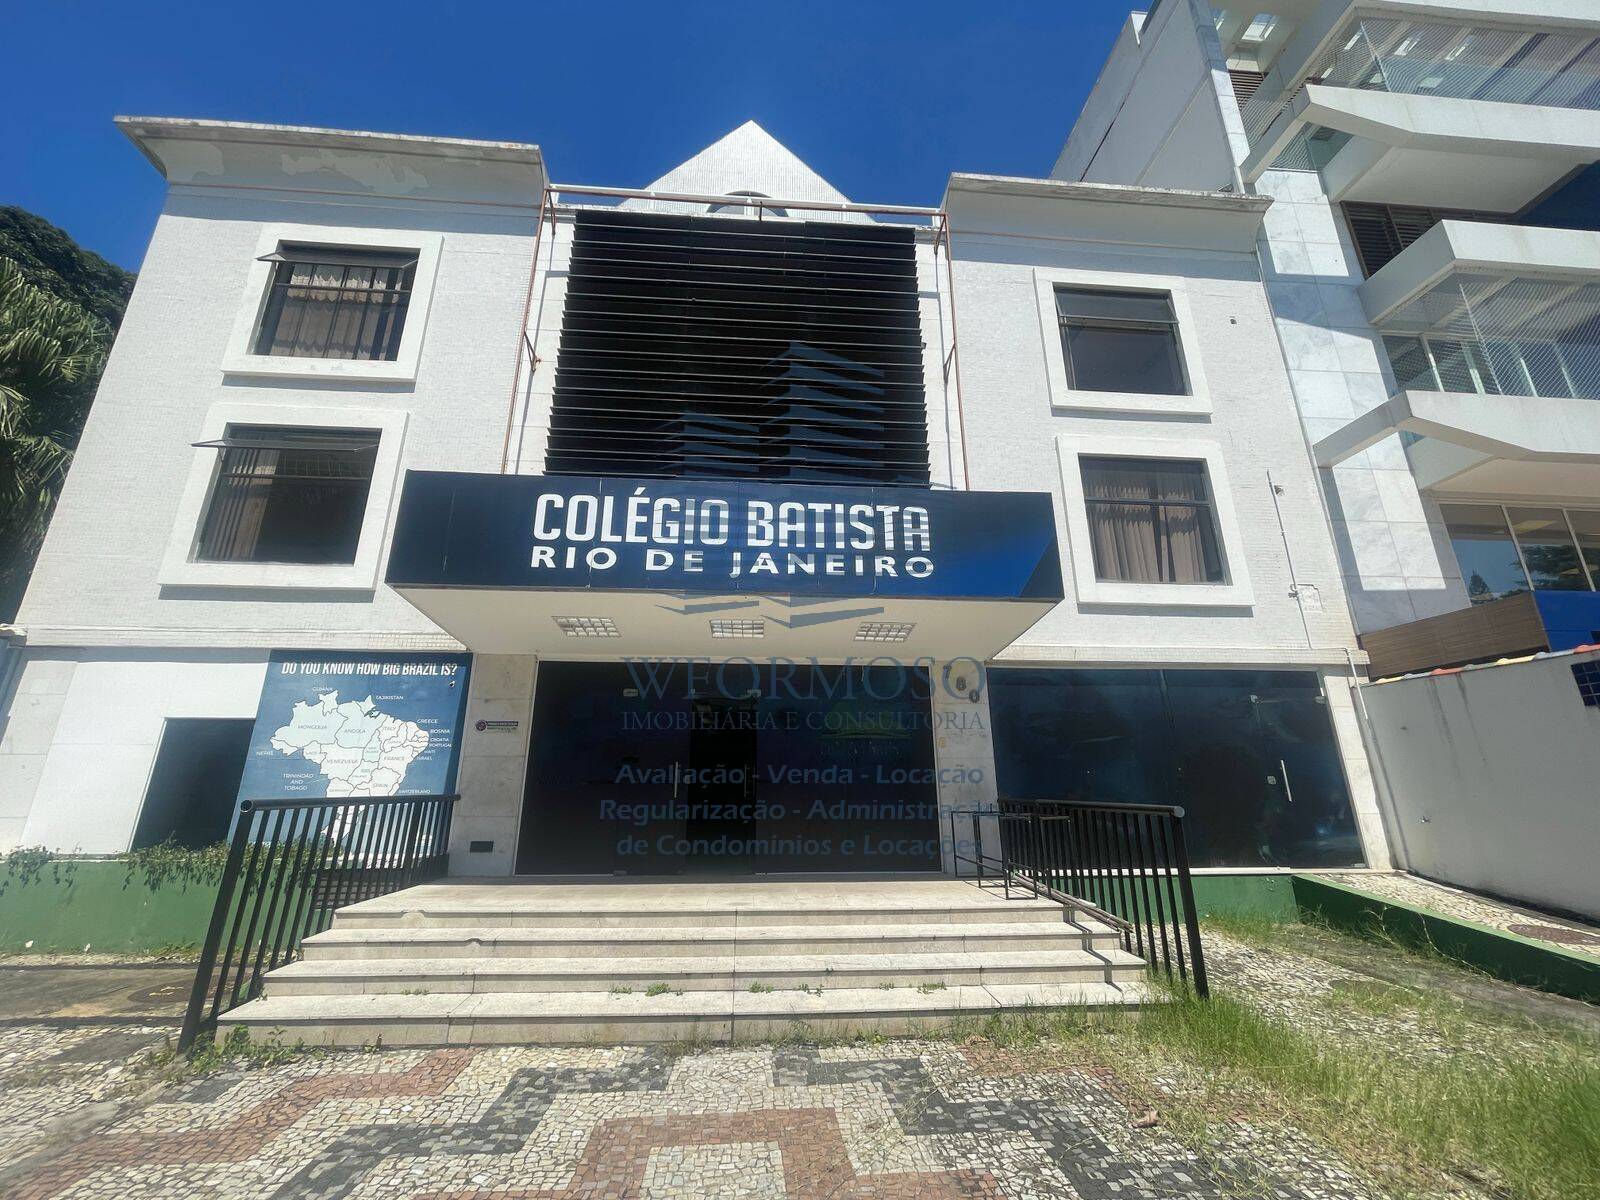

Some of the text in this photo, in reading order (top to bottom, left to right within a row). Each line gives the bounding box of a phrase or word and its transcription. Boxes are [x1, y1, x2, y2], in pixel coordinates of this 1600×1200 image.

[533, 486, 931, 552] COLÉGIO BATISTA
[530, 546, 935, 579] RIO DE JANEIRO
[281, 662, 458, 676] DO YOU KNOW HOW BIG BRAZIL IS?
